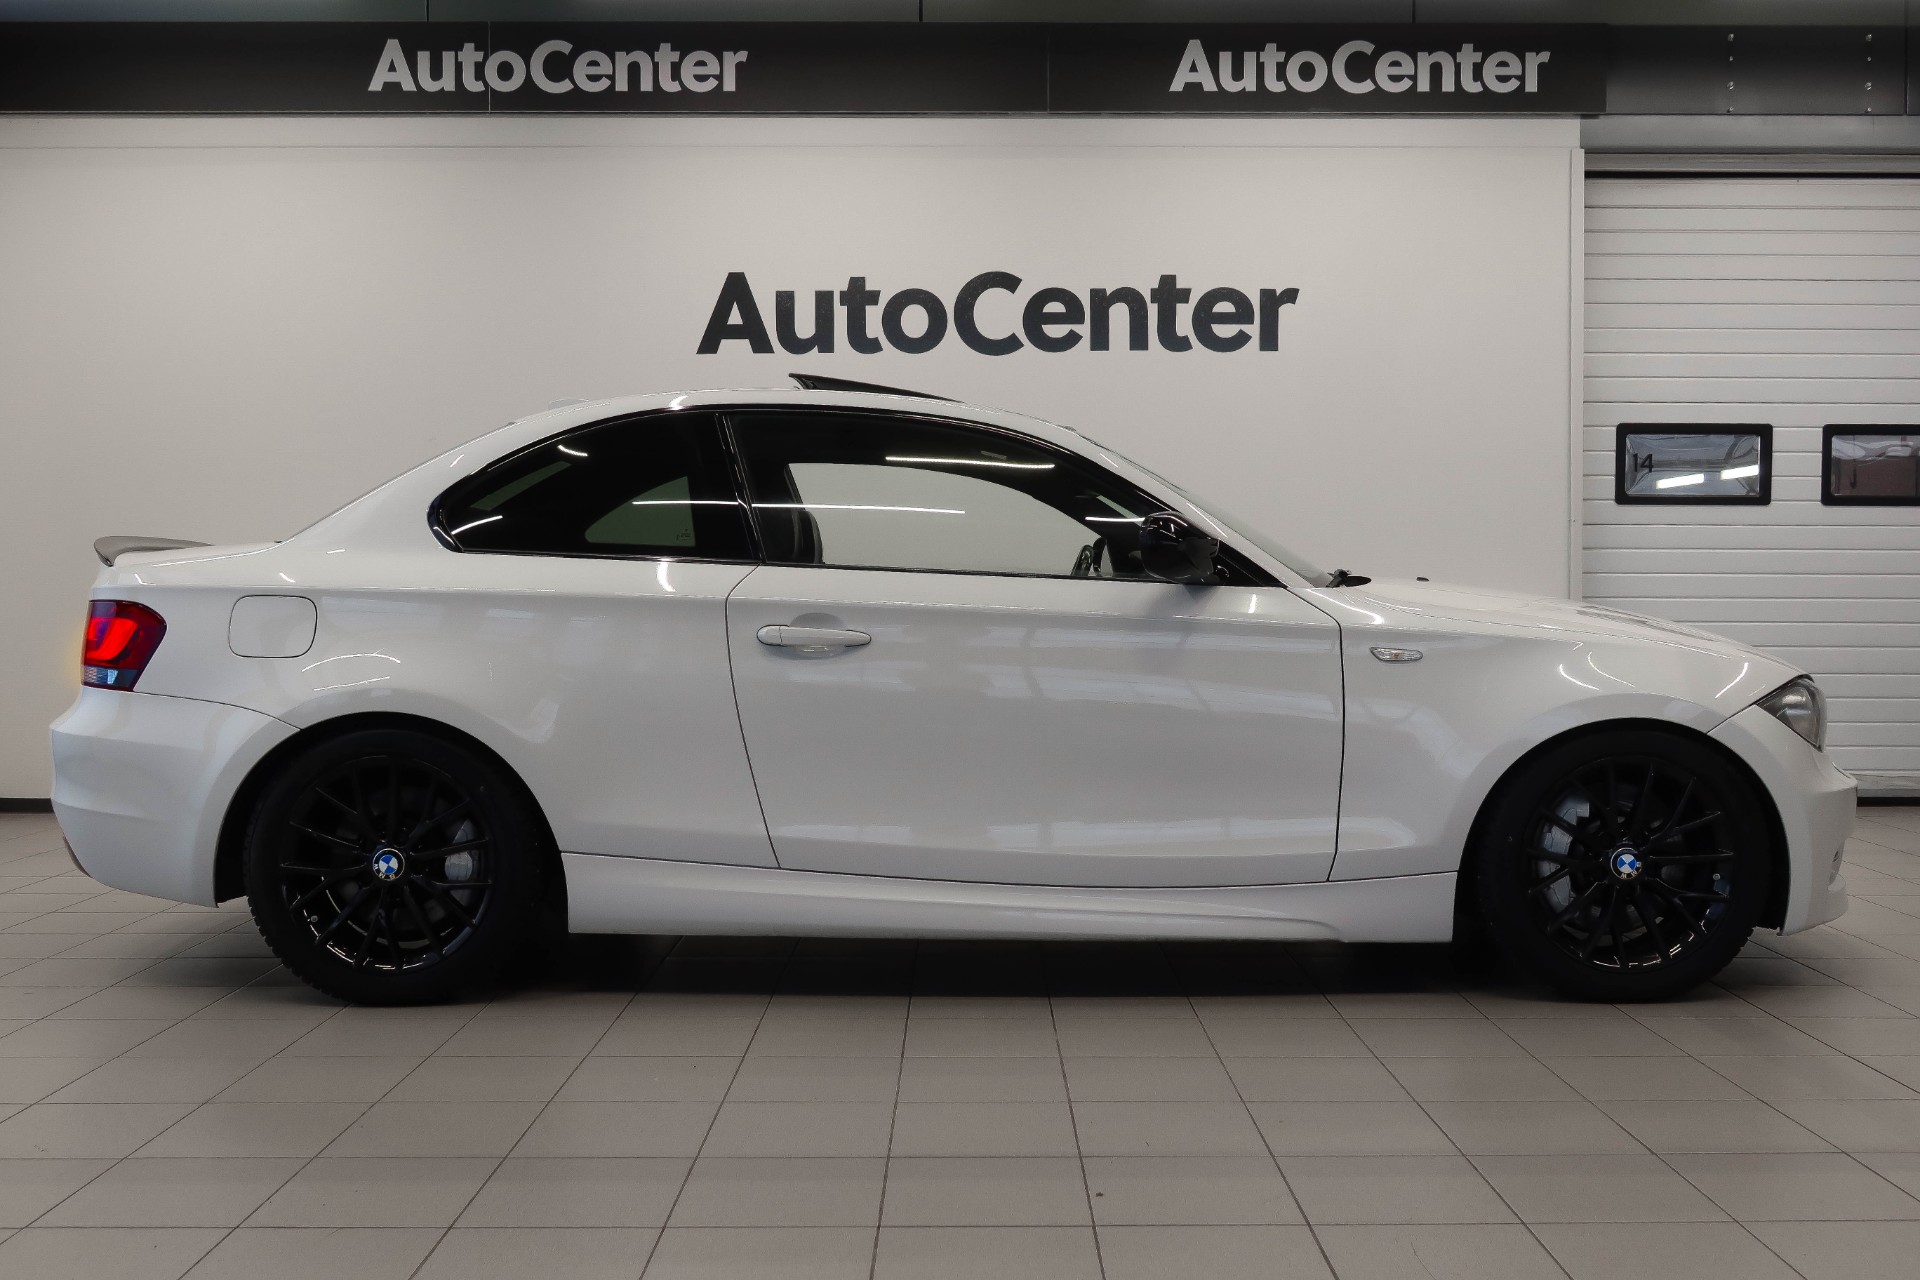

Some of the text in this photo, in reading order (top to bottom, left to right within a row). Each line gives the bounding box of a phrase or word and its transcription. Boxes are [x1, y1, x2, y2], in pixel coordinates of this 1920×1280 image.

[367, 38, 748, 94] AutoCenter
[1168, 39, 1551, 94] AutoCenter
[696, 271, 1299, 357] AutoCenter
[1633, 453, 1653, 473] 14
